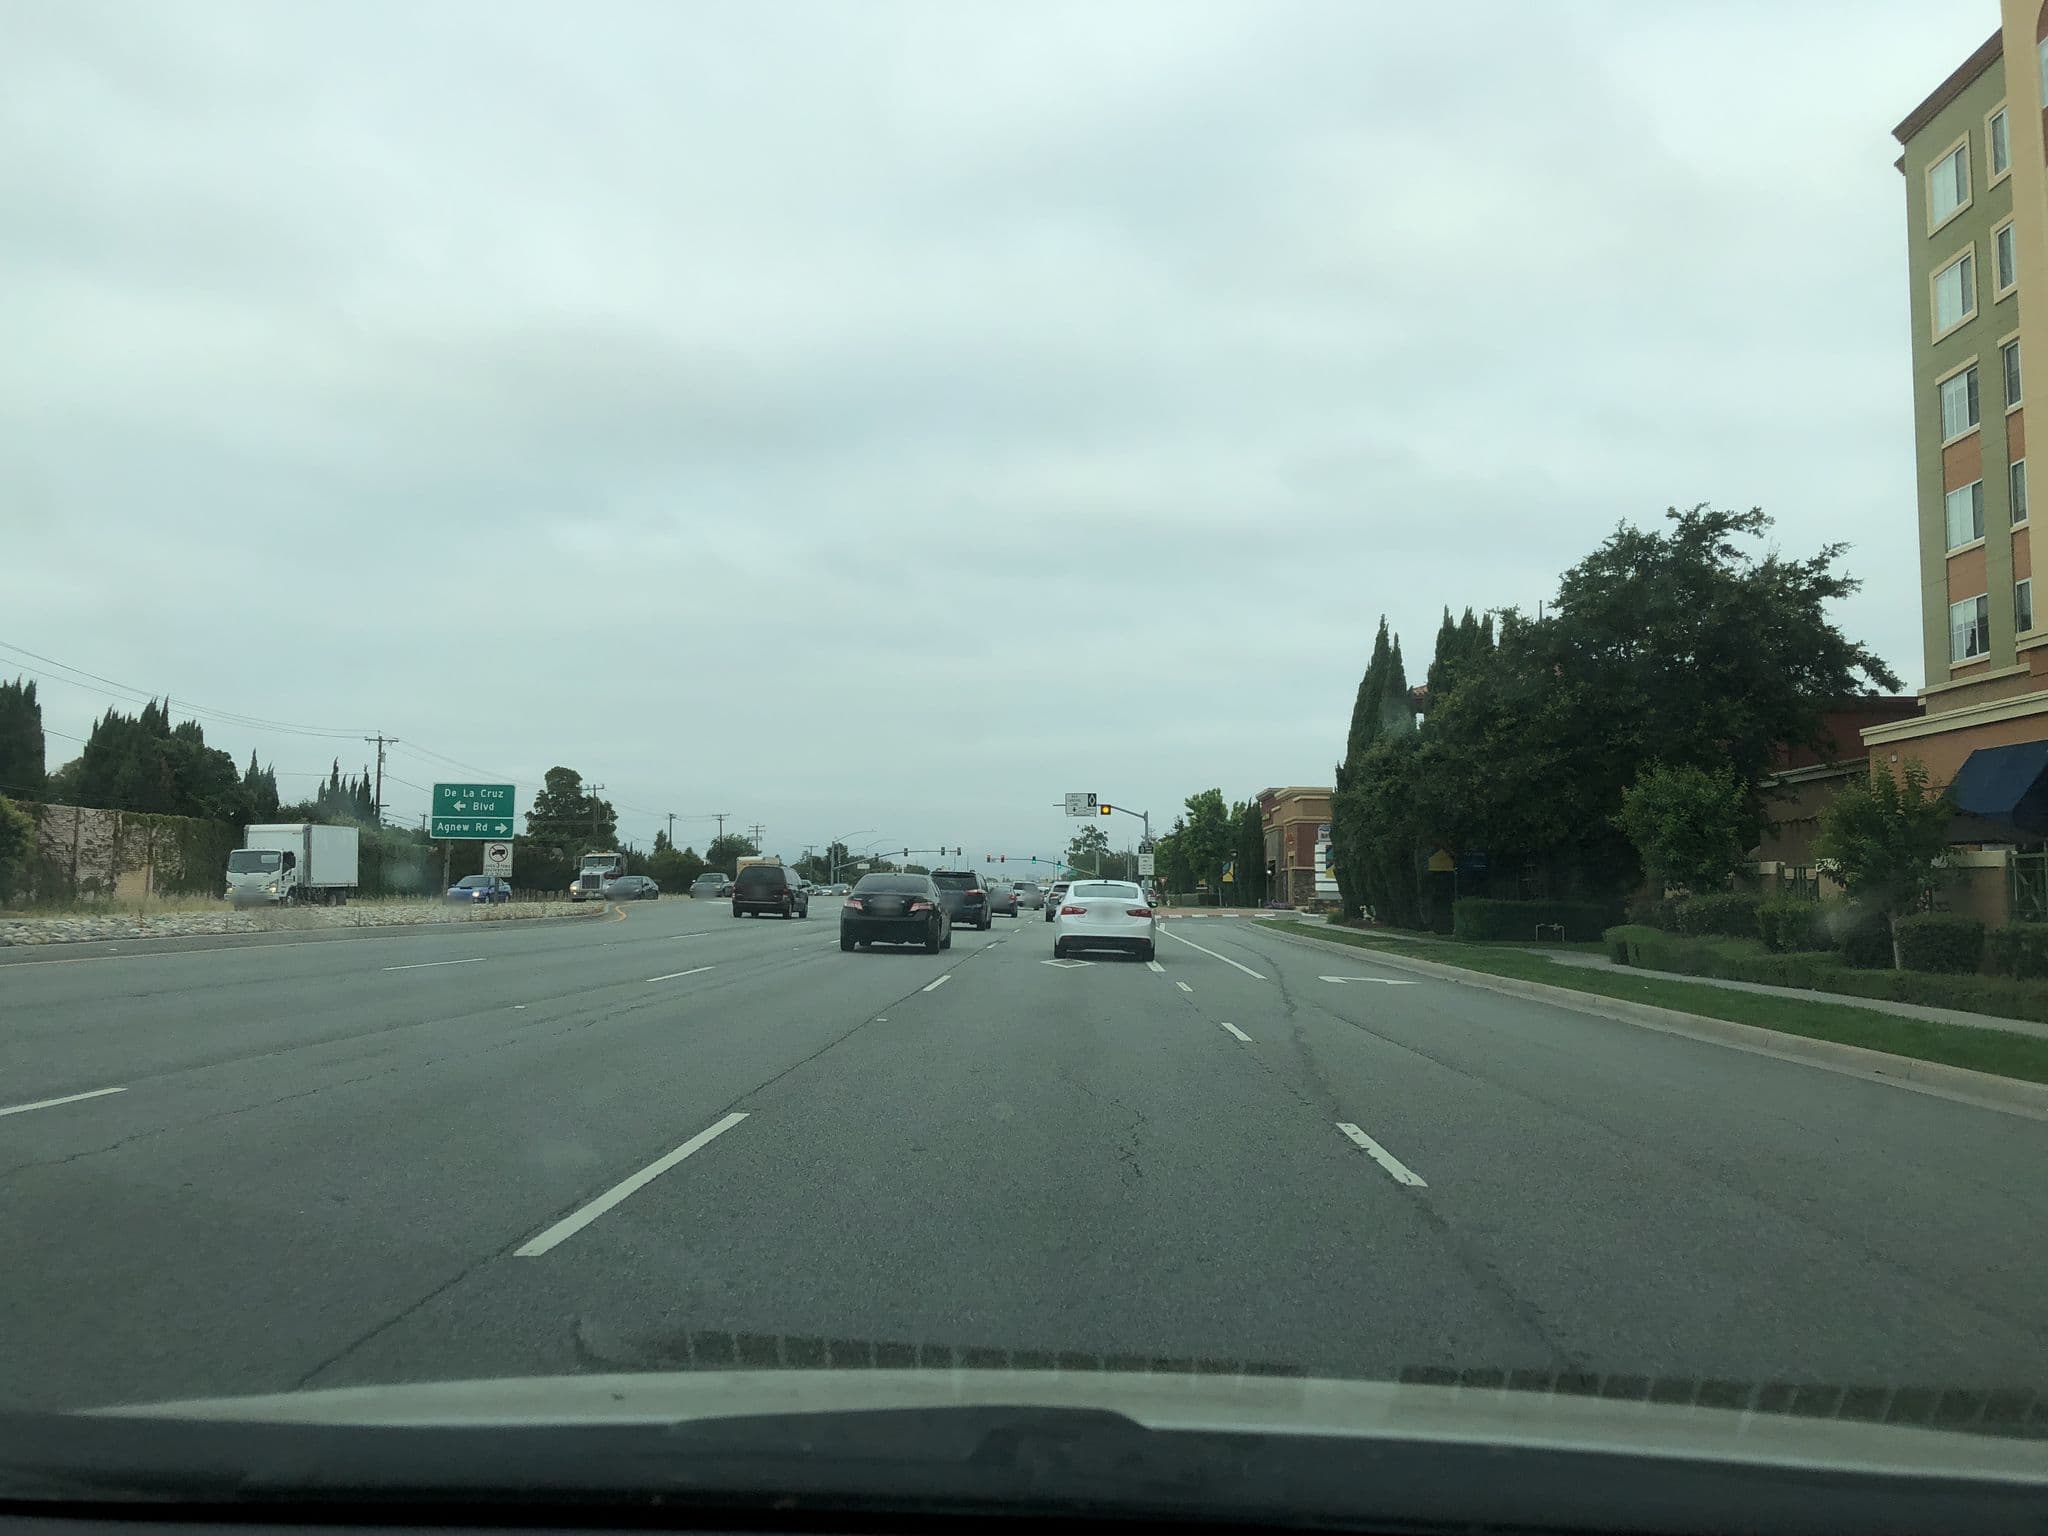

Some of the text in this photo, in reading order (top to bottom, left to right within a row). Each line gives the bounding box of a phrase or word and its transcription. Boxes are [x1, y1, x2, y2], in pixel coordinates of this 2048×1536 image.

[444, 788, 504, 799] De La Cruz
[473, 801, 495, 811] Blvd
[436, 822, 488, 834] Agnew Rd
